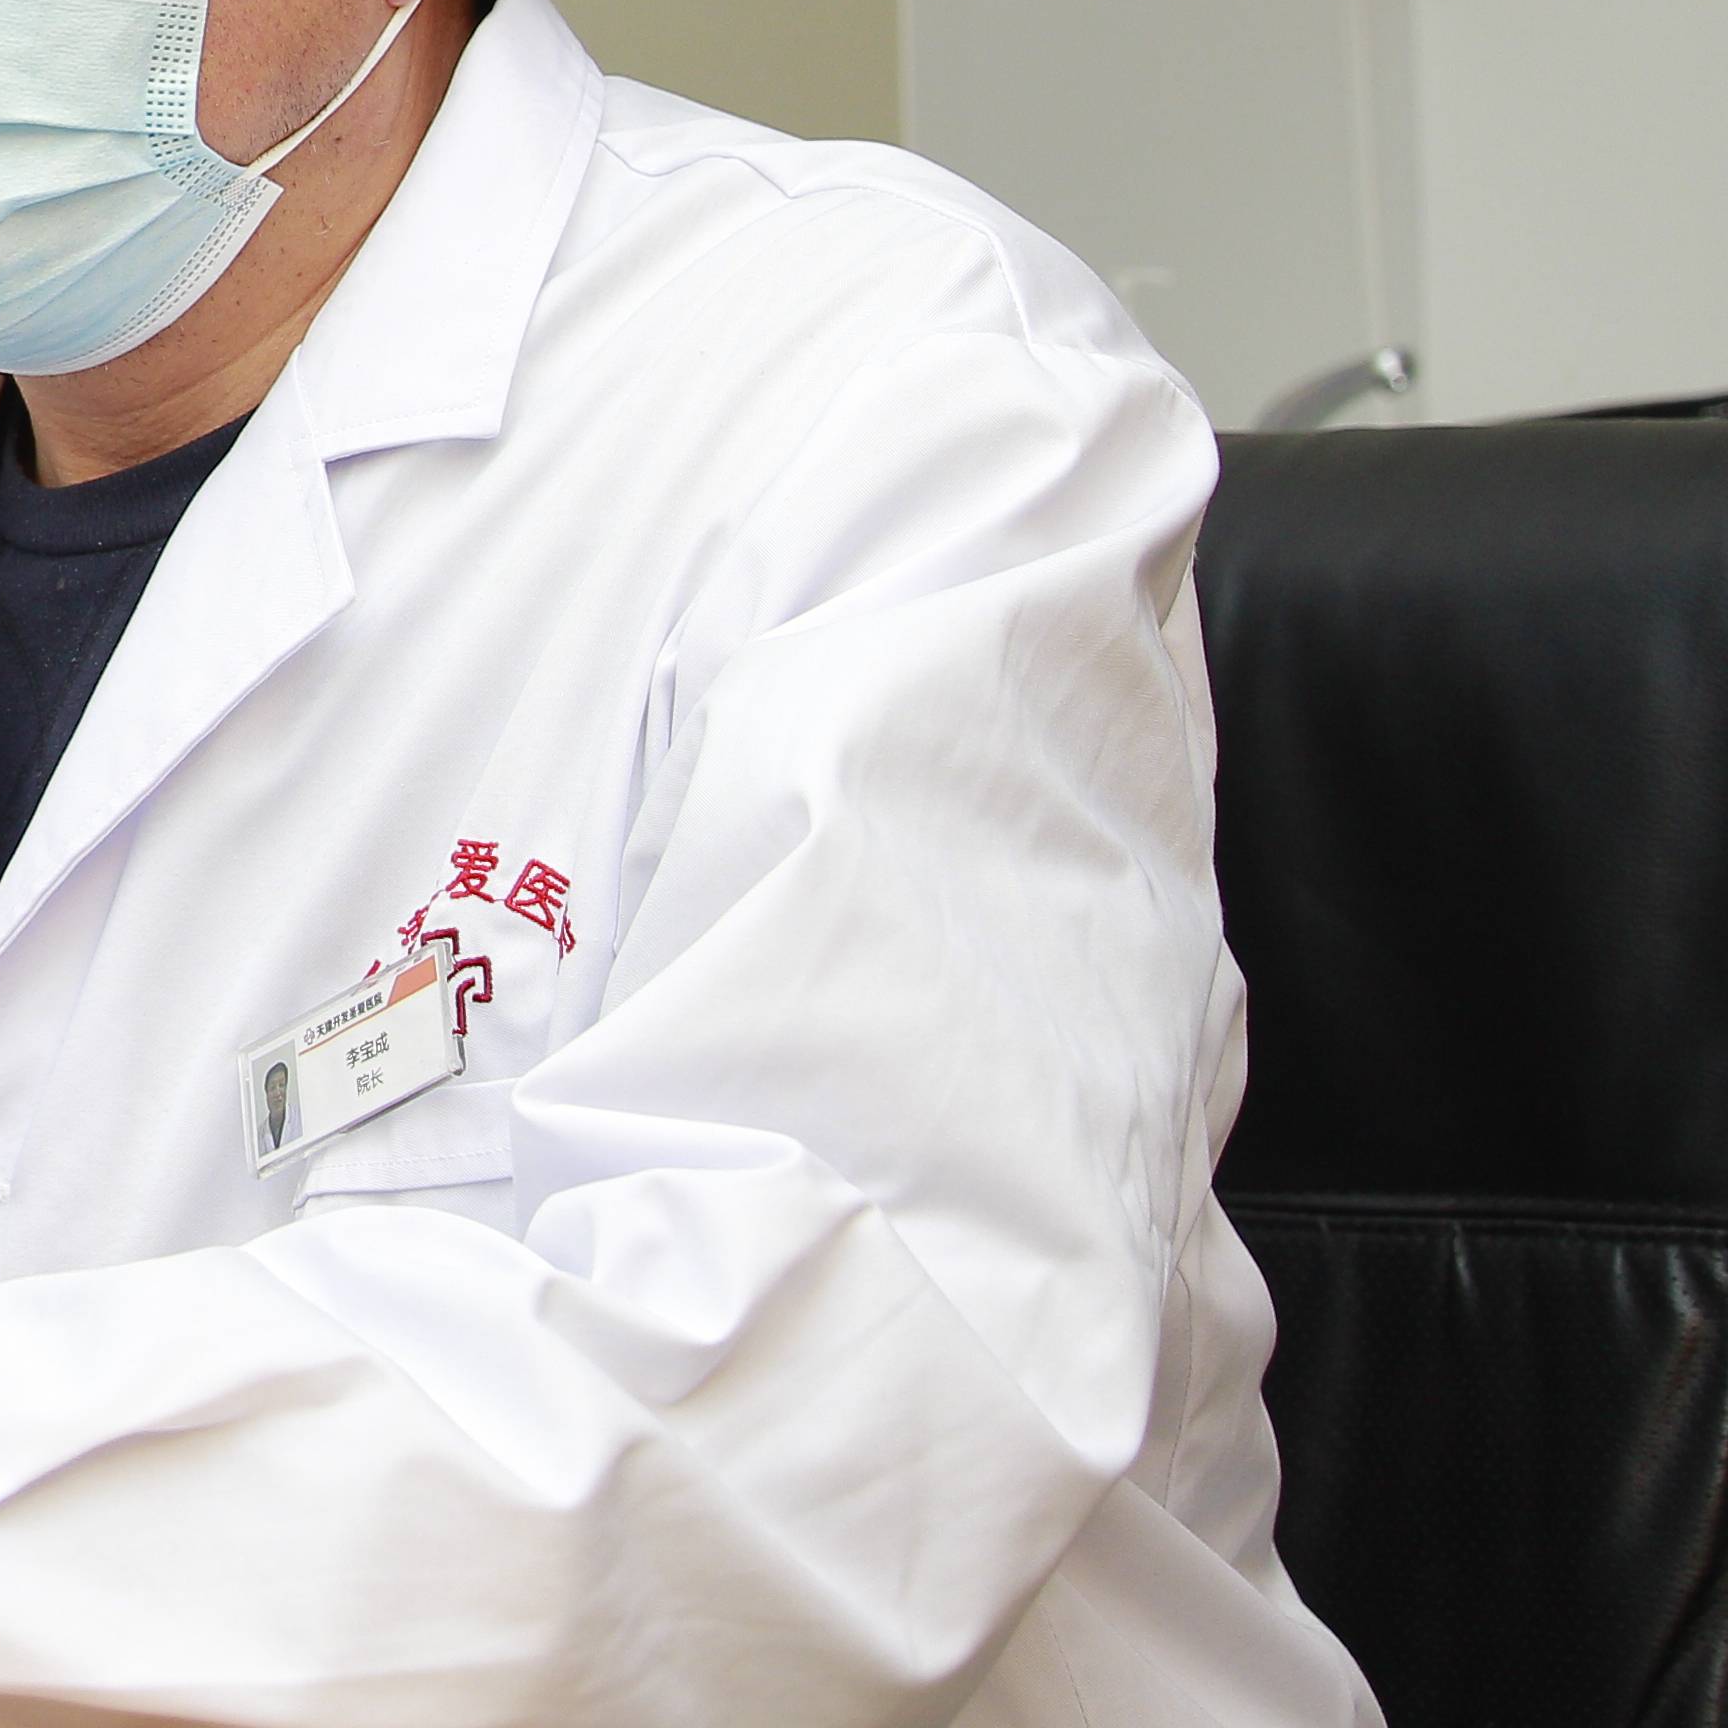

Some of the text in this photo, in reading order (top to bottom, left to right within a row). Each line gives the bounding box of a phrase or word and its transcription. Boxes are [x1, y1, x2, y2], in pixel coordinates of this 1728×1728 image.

[345, 1031, 390, 1070] 李宝成
[356, 1067, 384, 1097] 院长
